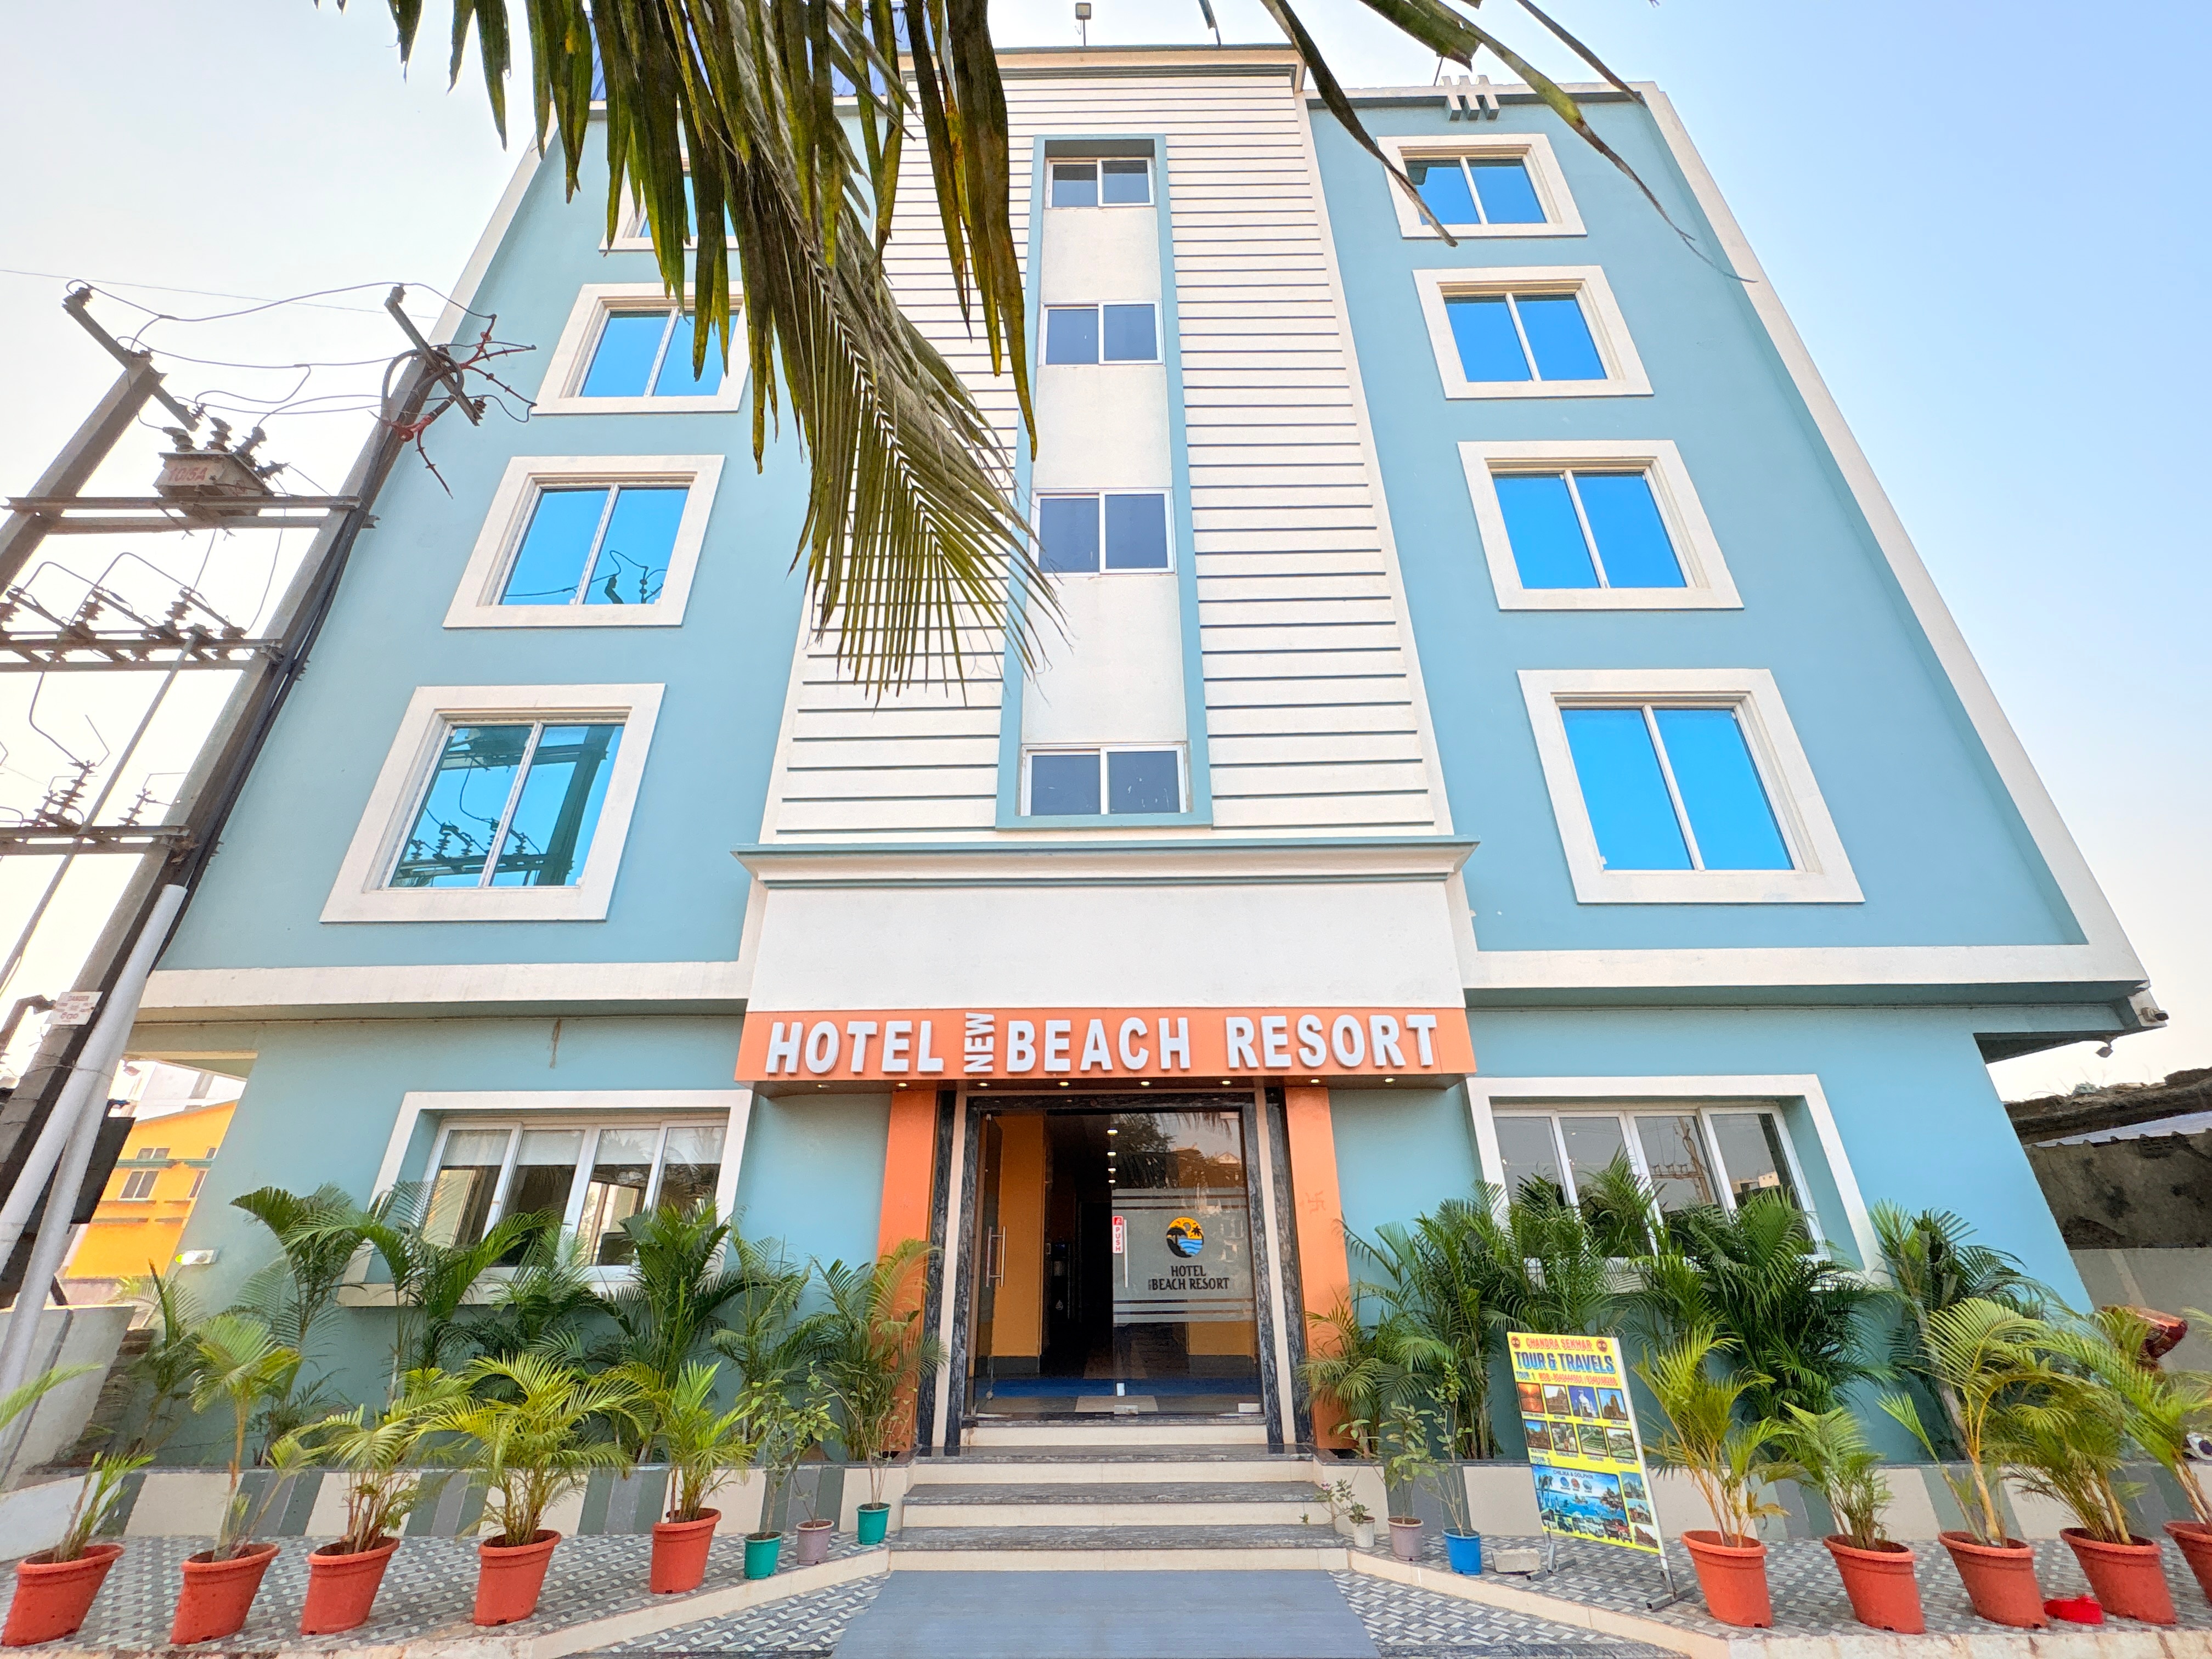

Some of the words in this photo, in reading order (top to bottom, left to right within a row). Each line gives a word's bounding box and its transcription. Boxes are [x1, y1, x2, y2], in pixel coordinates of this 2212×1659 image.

[765, 1020, 944, 1074] HOTEL
[963, 1012, 995, 1073] NEW
[1007, 1017, 1190, 1072] BEACH
[1226, 1014, 1437, 1068] RESORT
[1171, 1265, 1206, 1277] HOTEL
[1152, 1278, 1186, 1290] BEACH
[1189, 1277, 1229, 1290] RESORT
[1526, 1338, 1560, 1349] CHANDRA
[1561, 1338, 1593, 1350] SEKHAR
[1514, 1352, 1547, 1370] TOUR
[1547, 1353, 1558, 1370] &
[1558, 1353, 1616, 1374] TRAVELS
